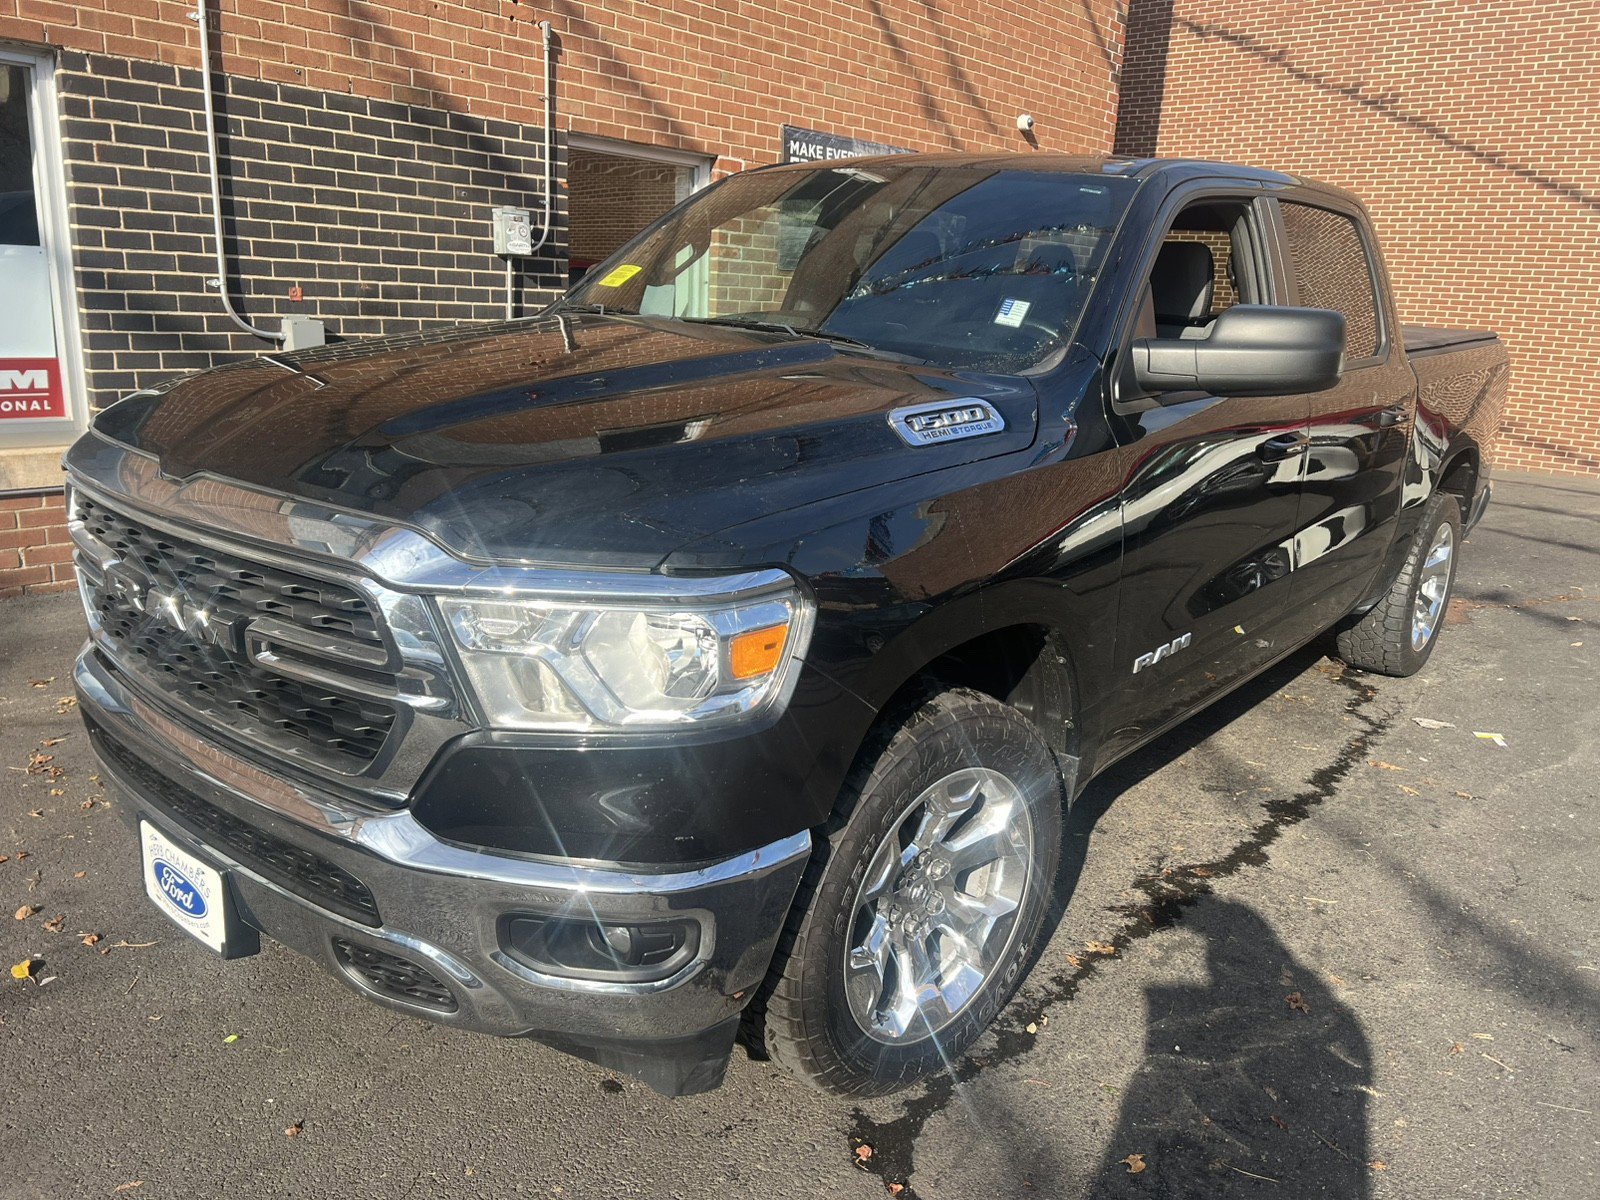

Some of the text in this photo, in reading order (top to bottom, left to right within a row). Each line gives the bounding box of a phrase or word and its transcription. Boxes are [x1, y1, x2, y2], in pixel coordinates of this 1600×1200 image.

[790, 140, 824, 160] MAKE
[0, 400, 52, 412] ONAL
[907, 407, 985, 432] 1500
[922, 430, 951, 440] HEMI
[1132, 632, 1192, 674] RAM
[165, 848, 211, 899] CHAMBERS
[161, 866, 194, 910] Ford
